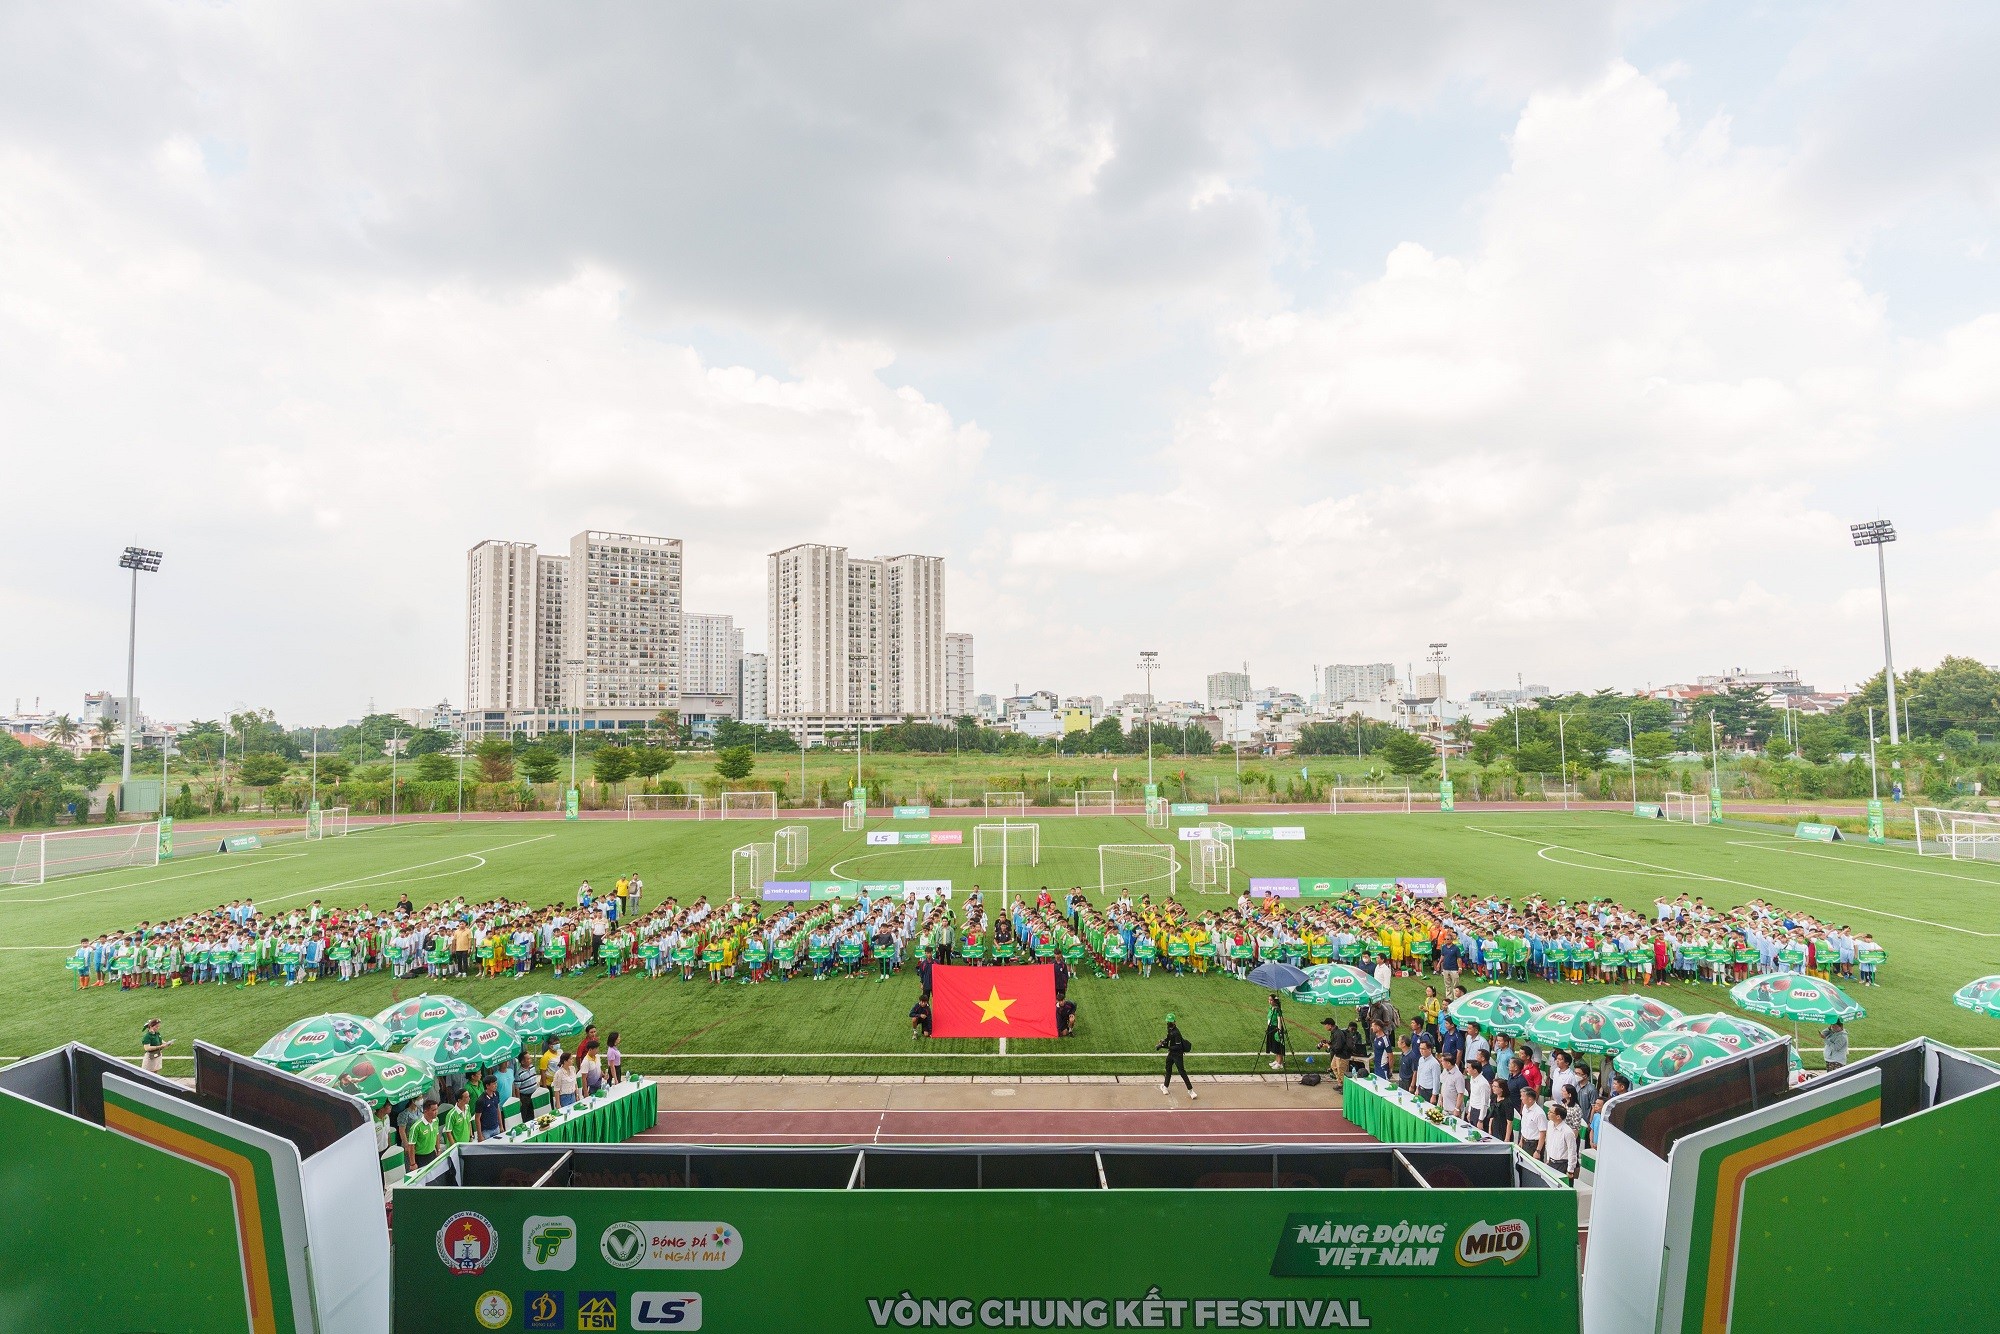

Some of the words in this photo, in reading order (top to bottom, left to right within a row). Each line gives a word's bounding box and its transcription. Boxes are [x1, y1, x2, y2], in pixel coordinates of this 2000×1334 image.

[1793, 990, 1817, 998] MILO
[1470, 999, 1490, 1009] MILO
[423, 1008, 446, 1018] MILO
[545, 1008, 565, 1016] MILO
[1549, 1012, 1571, 1022] MILO
[1616, 1020, 1634, 1029] MILO
[298, 1033, 326, 1043] MILO
[479, 1031, 498, 1041] MILO
[1637, 1042, 1656, 1055] MILO
[383, 1065, 405, 1078] MILO
[309, 1075, 332, 1085] MILO
[651, 1235, 686, 1248] BÓNG
[691, 1233, 708, 1248] ĐÁ
[1294, 1220, 1369, 1244] NĂNG
[1370, 1219, 1446, 1249] ĐỘNG
[1465, 1231, 1524, 1256] MILO
[665, 1249, 698, 1262] NGÀY
[702, 1251, 726, 1262] MAI
[1315, 1244, 1378, 1270] VIỆT
[1374, 1247, 1439, 1266] NAM
[638, 1300, 687, 1324] LS
[867, 1291, 973, 1327] VÒNG
[979, 1299, 1108, 1327] CHUNG
[1115, 1286, 1188, 1327] KẾT
[1195, 1299, 1370, 1327] FESTIVAL
[580, 1315, 615, 1328] TSN
